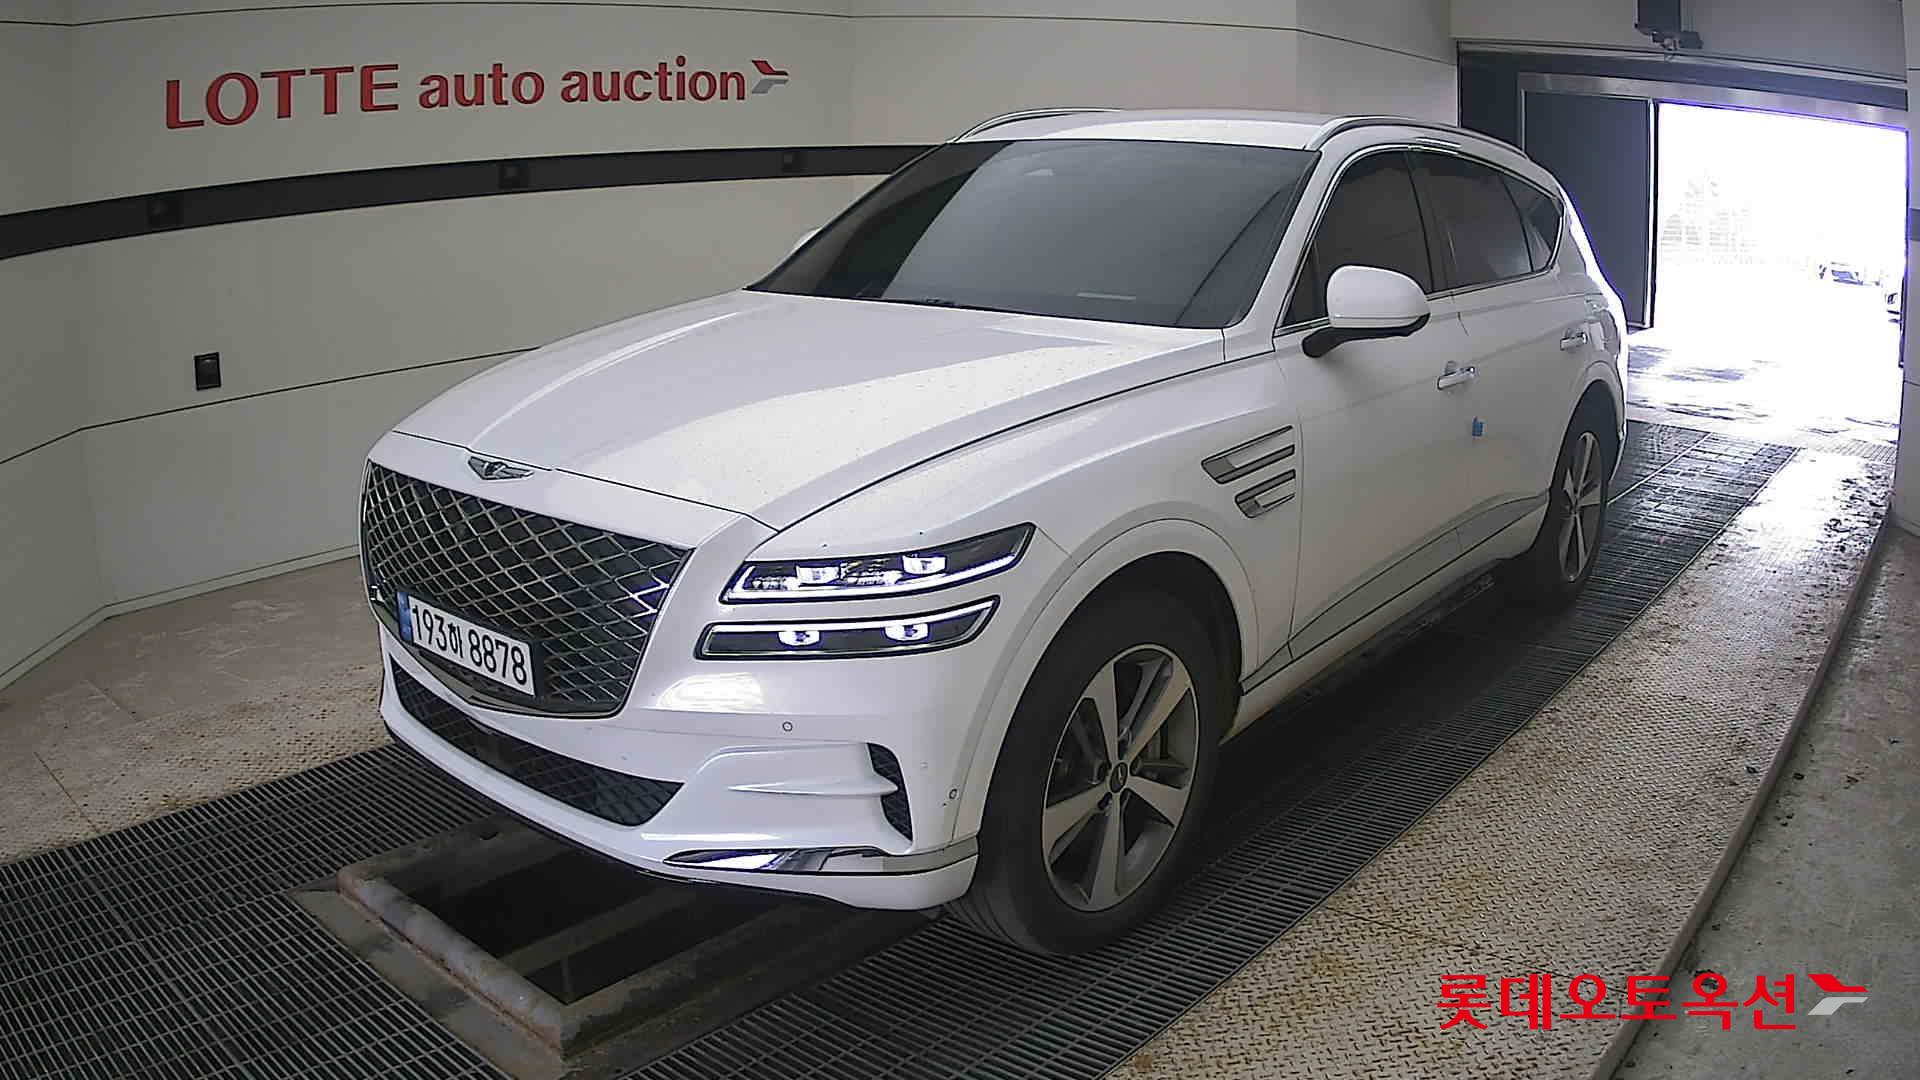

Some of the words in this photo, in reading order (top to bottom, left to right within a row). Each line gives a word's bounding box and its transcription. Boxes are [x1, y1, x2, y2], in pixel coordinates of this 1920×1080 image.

[166, 64, 399, 129] LOTTE
[418, 63, 545, 108] auto
[560, 56, 746, 103] auction
[468, 629, 527, 685] 8878
